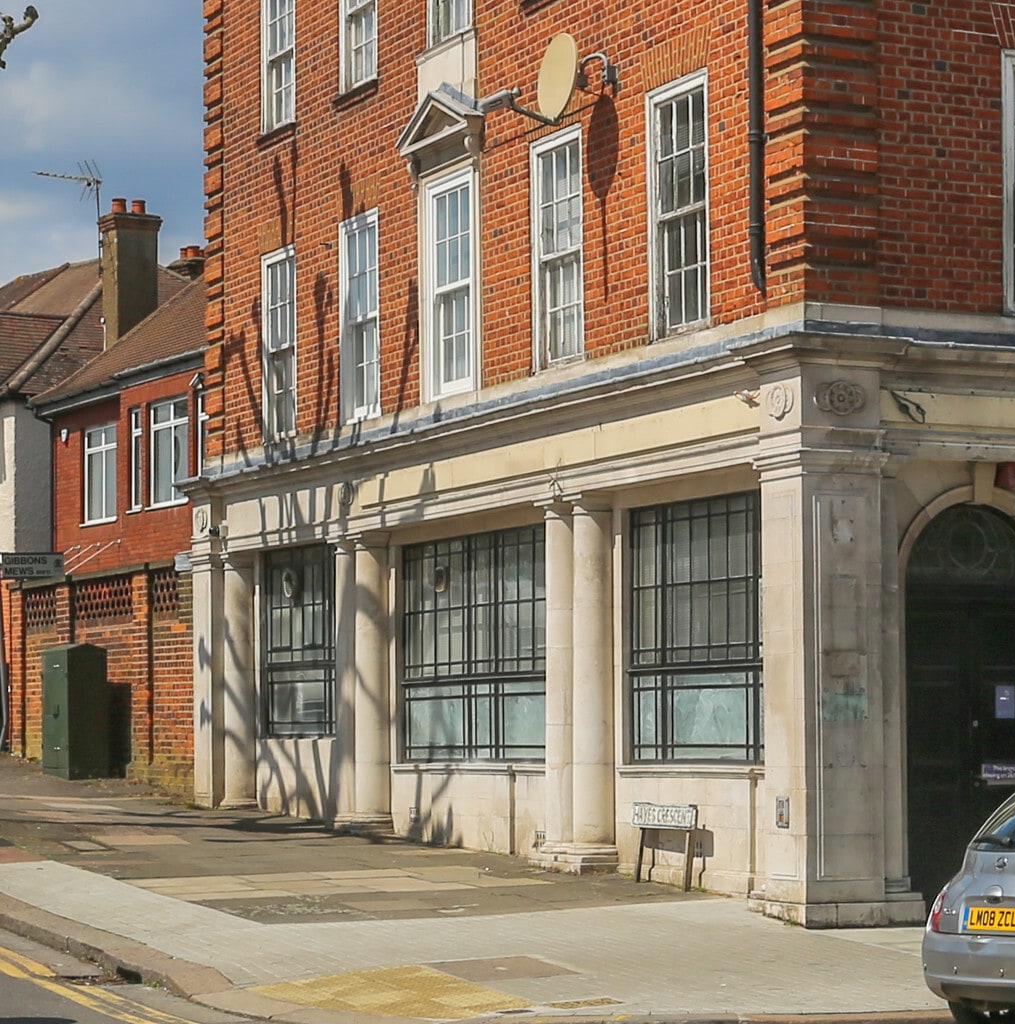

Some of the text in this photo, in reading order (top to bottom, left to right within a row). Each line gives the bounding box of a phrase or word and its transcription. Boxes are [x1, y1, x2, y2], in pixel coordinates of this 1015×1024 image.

[4, 556, 48, 565] GIBBONS
[4, 567, 34, 576] MEWS
[633, 804, 692, 825] HAYES CRESCENT
[969, 909, 996, 926] LM08
